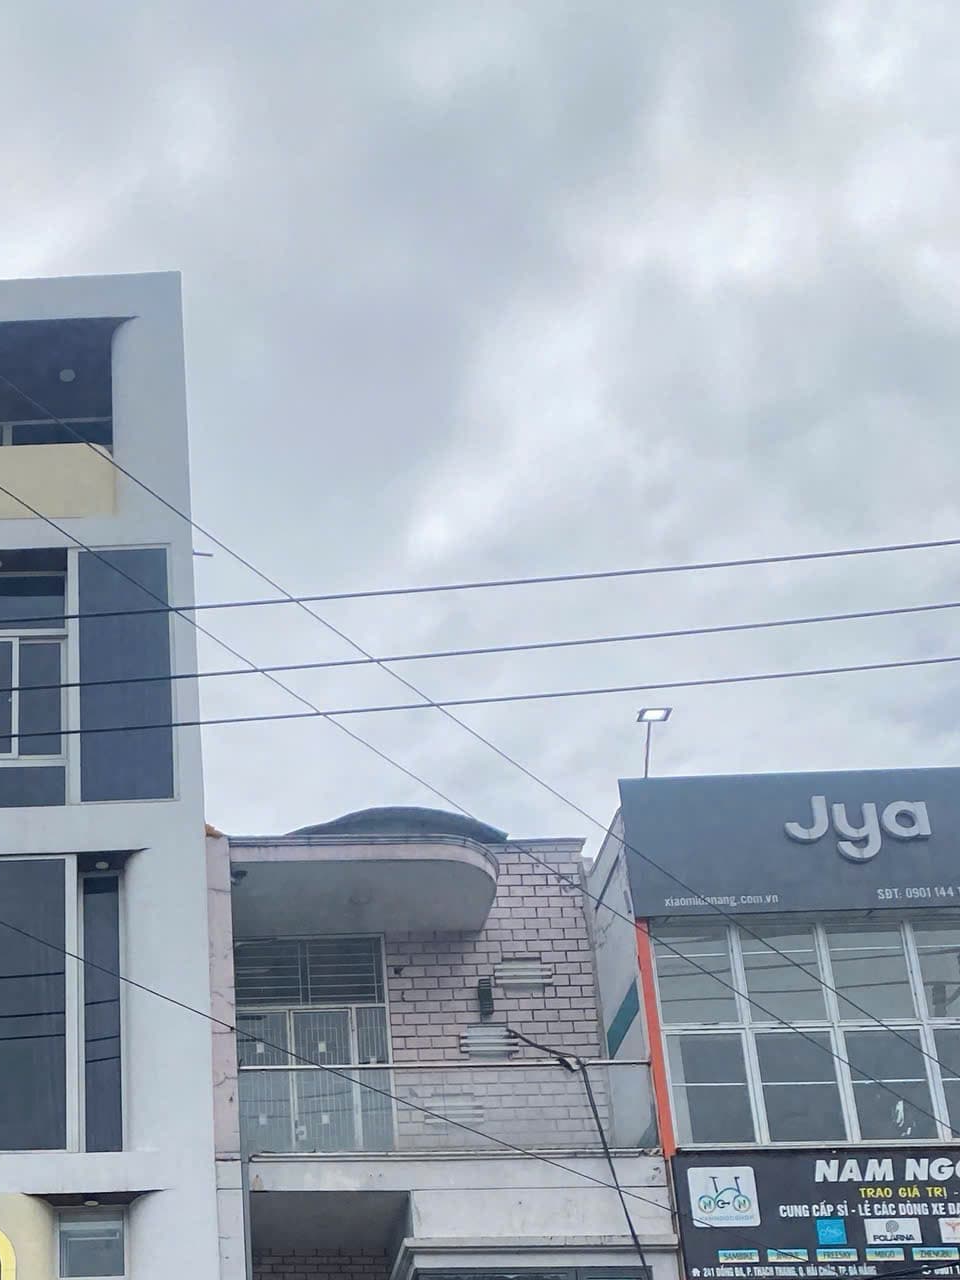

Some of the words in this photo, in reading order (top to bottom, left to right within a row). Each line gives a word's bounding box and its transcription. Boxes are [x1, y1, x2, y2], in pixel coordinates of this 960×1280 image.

[783, 795, 932, 863] Jya
[906, 887, 931, 898] 0901
[815, 1158, 894, 1182] NAM
[859, 1187, 893, 1198] TRAO
[898, 1184, 921, 1198] GIÁ
[926, 1187, 948, 1200] TRỊ
[779, 1205, 810, 1218] CUNG
[812, 1202, 834, 1217] CẤP
[874, 1201, 897, 1216] CÁC
[899, 1200, 929, 1216] DÒNG
[931, 1203, 946, 1215] XE
